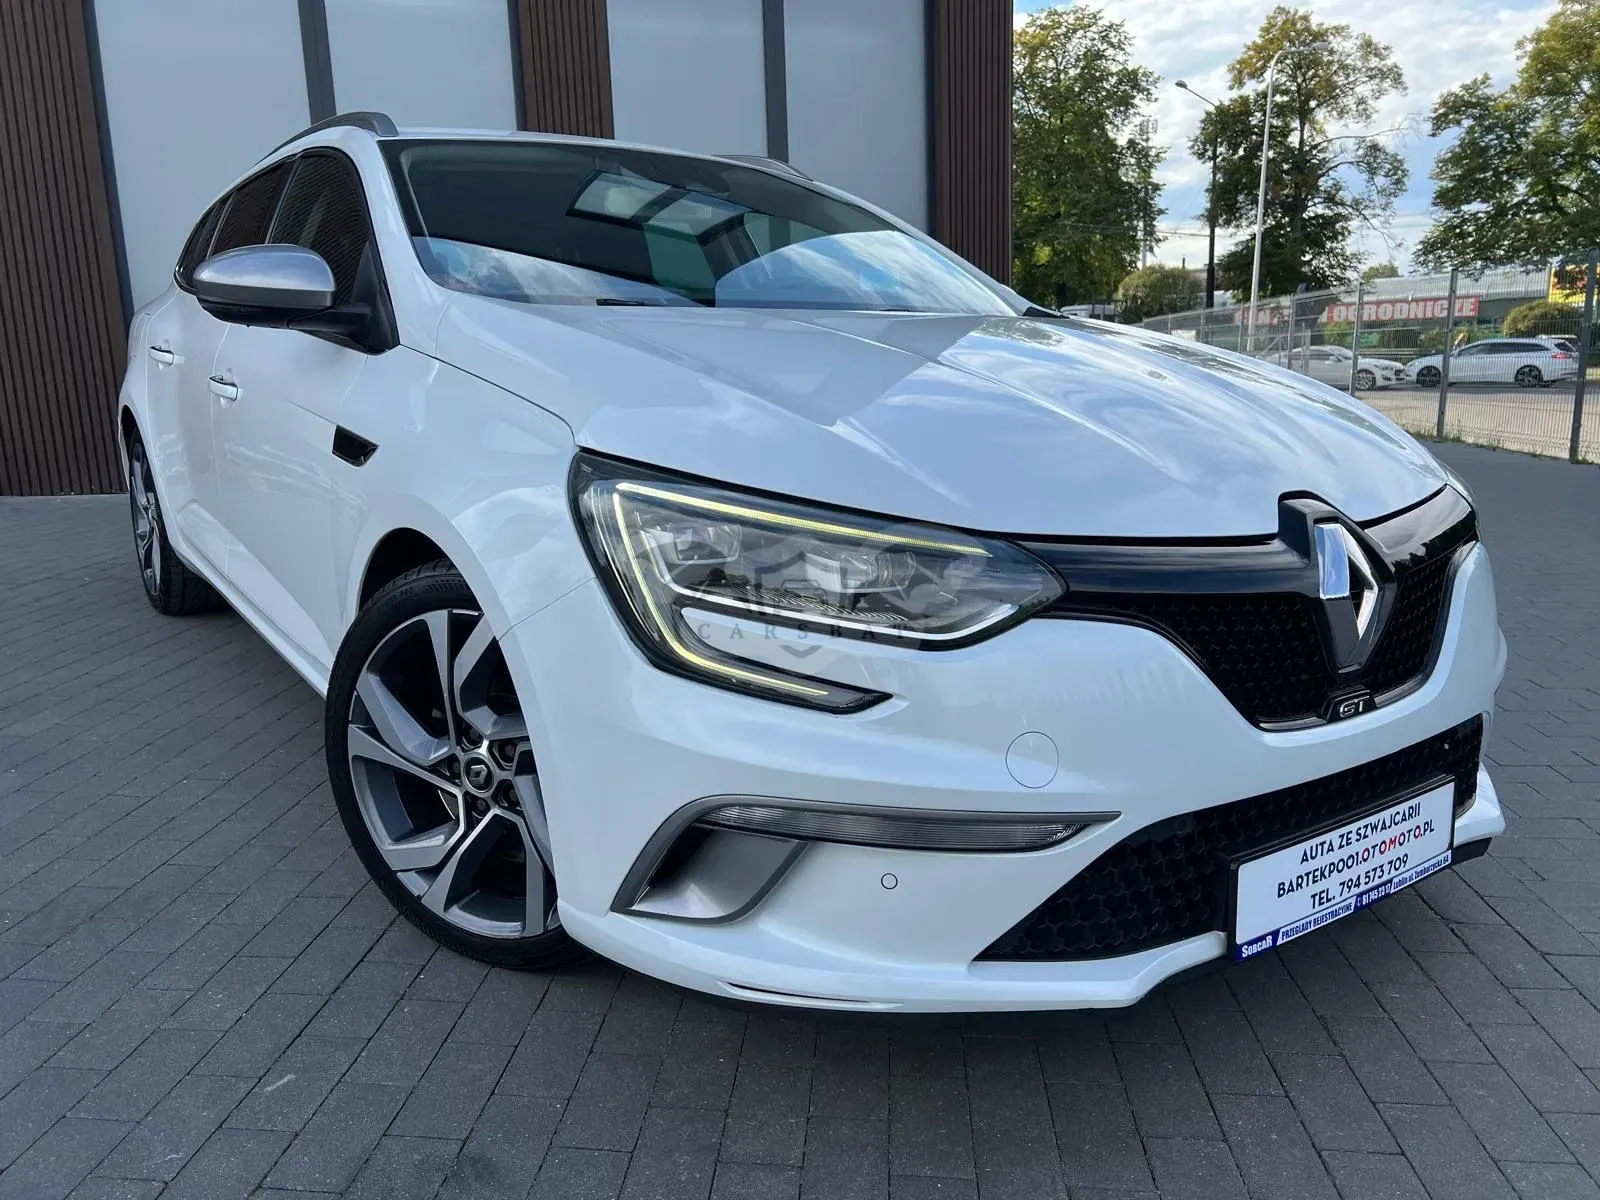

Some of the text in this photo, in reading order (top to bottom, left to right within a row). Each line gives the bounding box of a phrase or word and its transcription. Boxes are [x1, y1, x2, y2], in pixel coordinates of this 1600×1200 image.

[1339, 695, 1370, 718] GT
[1300, 802, 1421, 864] AUTA ZE SZWAJCARII
[1310, 853, 1409, 909] TEL. 794 573 709
